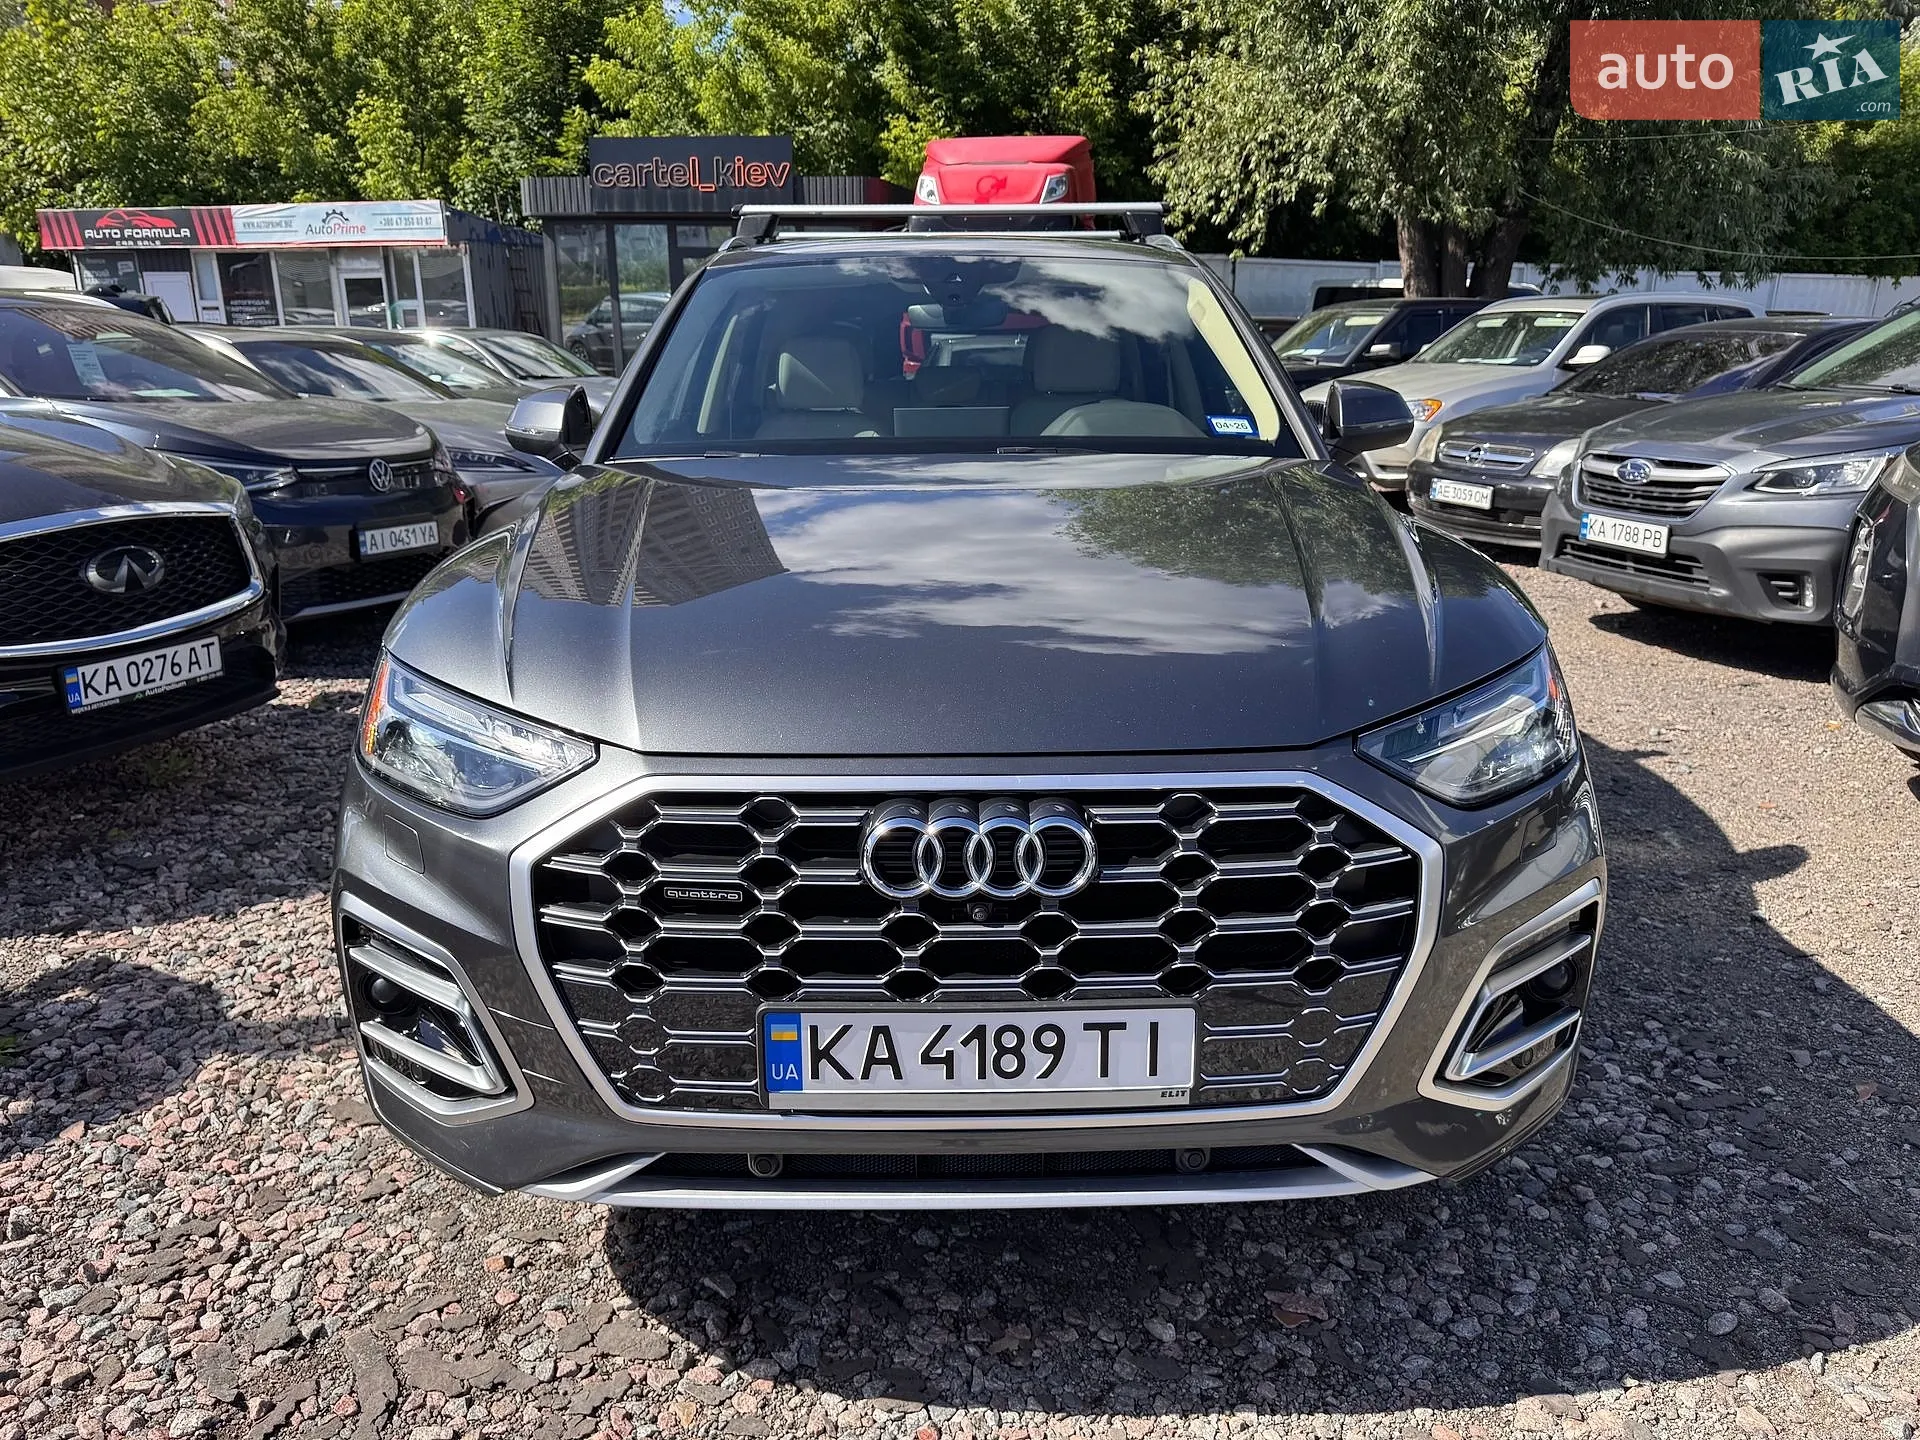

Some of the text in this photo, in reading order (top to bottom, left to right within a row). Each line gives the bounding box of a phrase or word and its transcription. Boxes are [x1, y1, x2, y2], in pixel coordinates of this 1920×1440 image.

[592, 155, 791, 192] cartel_kiev
[85, 228, 190, 239] AUTO FORMULA
[305, 223, 366, 236] AutoPrime
[1451, 487, 1473, 502] 3059
[370, 525, 436, 552] AI 0431 YA
[1588, 518, 1662, 548] KA 1788 PB
[81, 642, 215, 699] KA 0276 AT
[67, 692, 81, 704] UA
[667, 889, 739, 900] quattro
[809, 1021, 1160, 1080] KA 4189 TI
[771, 1062, 799, 1081] UA
